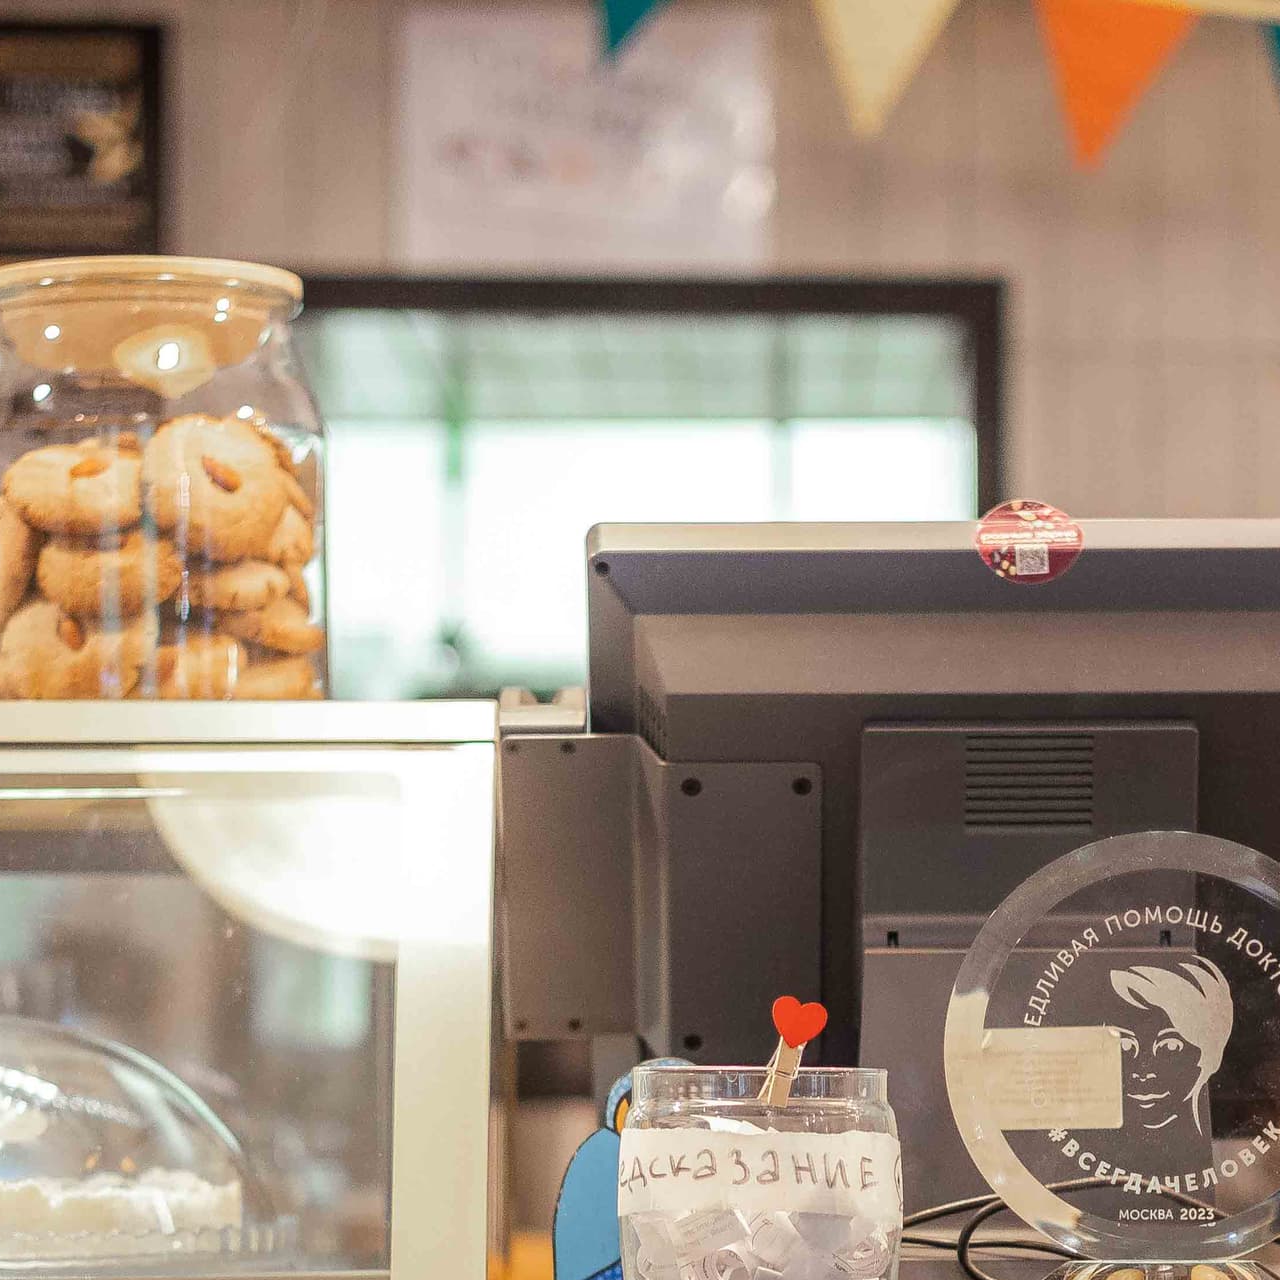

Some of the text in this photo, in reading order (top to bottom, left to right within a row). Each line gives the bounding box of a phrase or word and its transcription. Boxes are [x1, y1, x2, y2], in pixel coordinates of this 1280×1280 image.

[1104, 905, 1223, 935] ПОМОЩЬ
[1119, 1207, 1215, 1222] МОСКВА 2023
